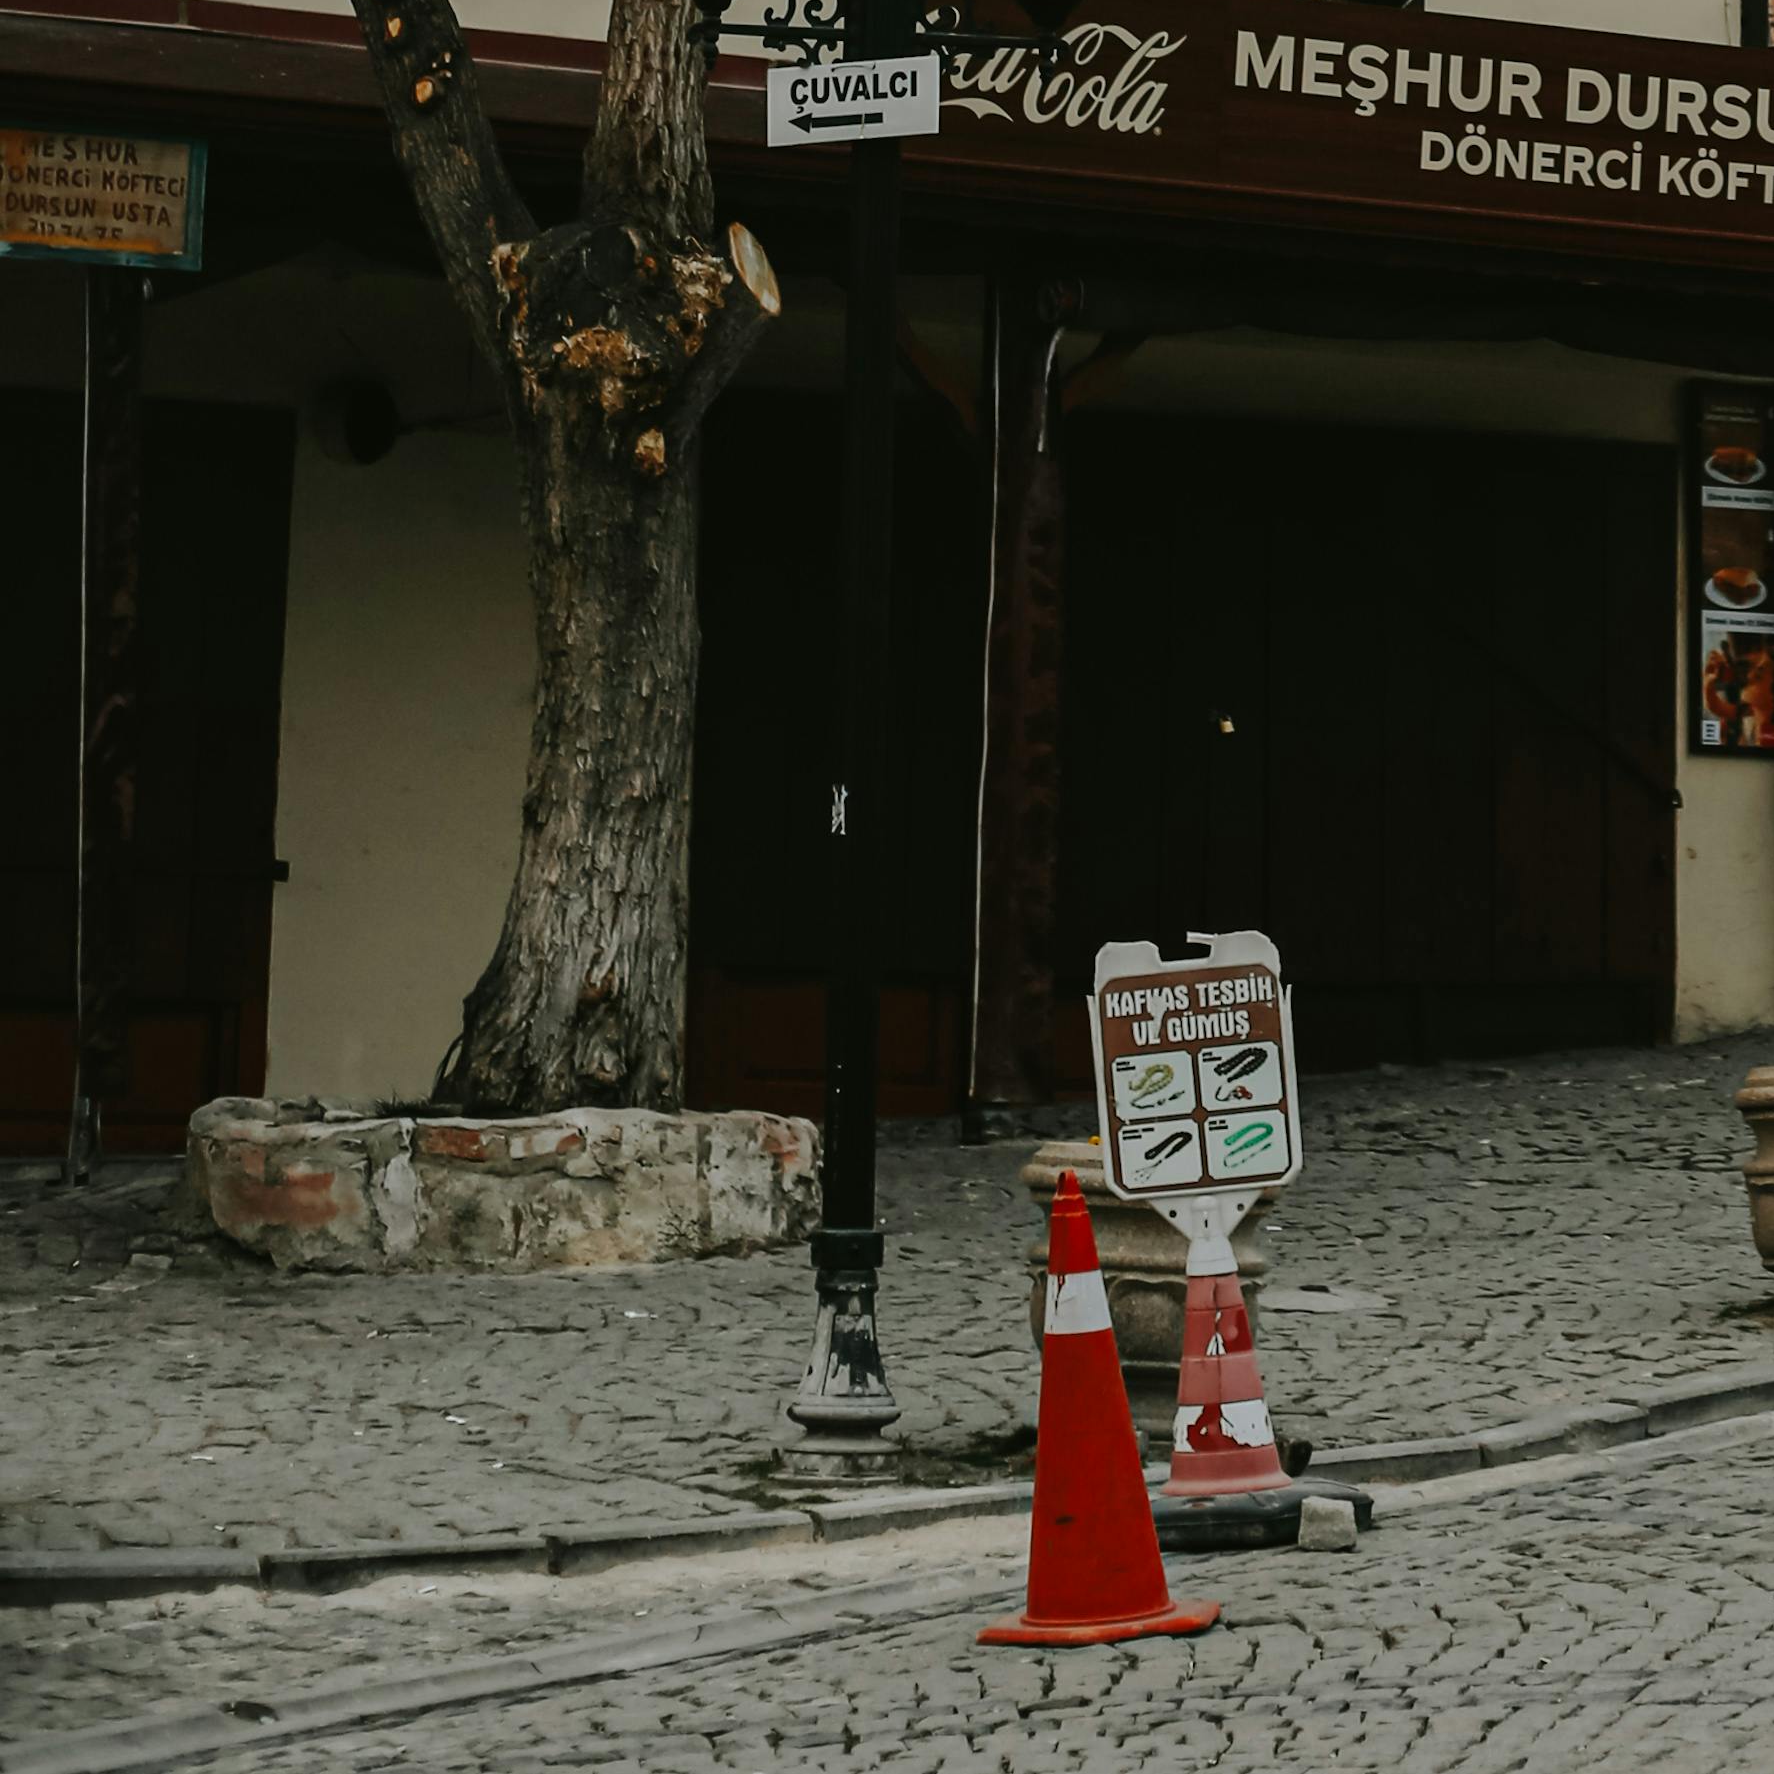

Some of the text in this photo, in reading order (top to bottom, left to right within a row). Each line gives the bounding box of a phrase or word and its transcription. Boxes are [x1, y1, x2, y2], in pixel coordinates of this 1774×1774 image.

[790, 70, 917, 114] ÇUVALCI
[1233, 30, 1543, 119] MEŞHUR
[1419, 123, 1643, 193] DÖNERCİ
[5, 190, 172, 227] DURSUN USTA
[1195, 972, 1273, 1007] TESBİH
[1165, 1006, 1252, 1040] GÜMÜŞ
